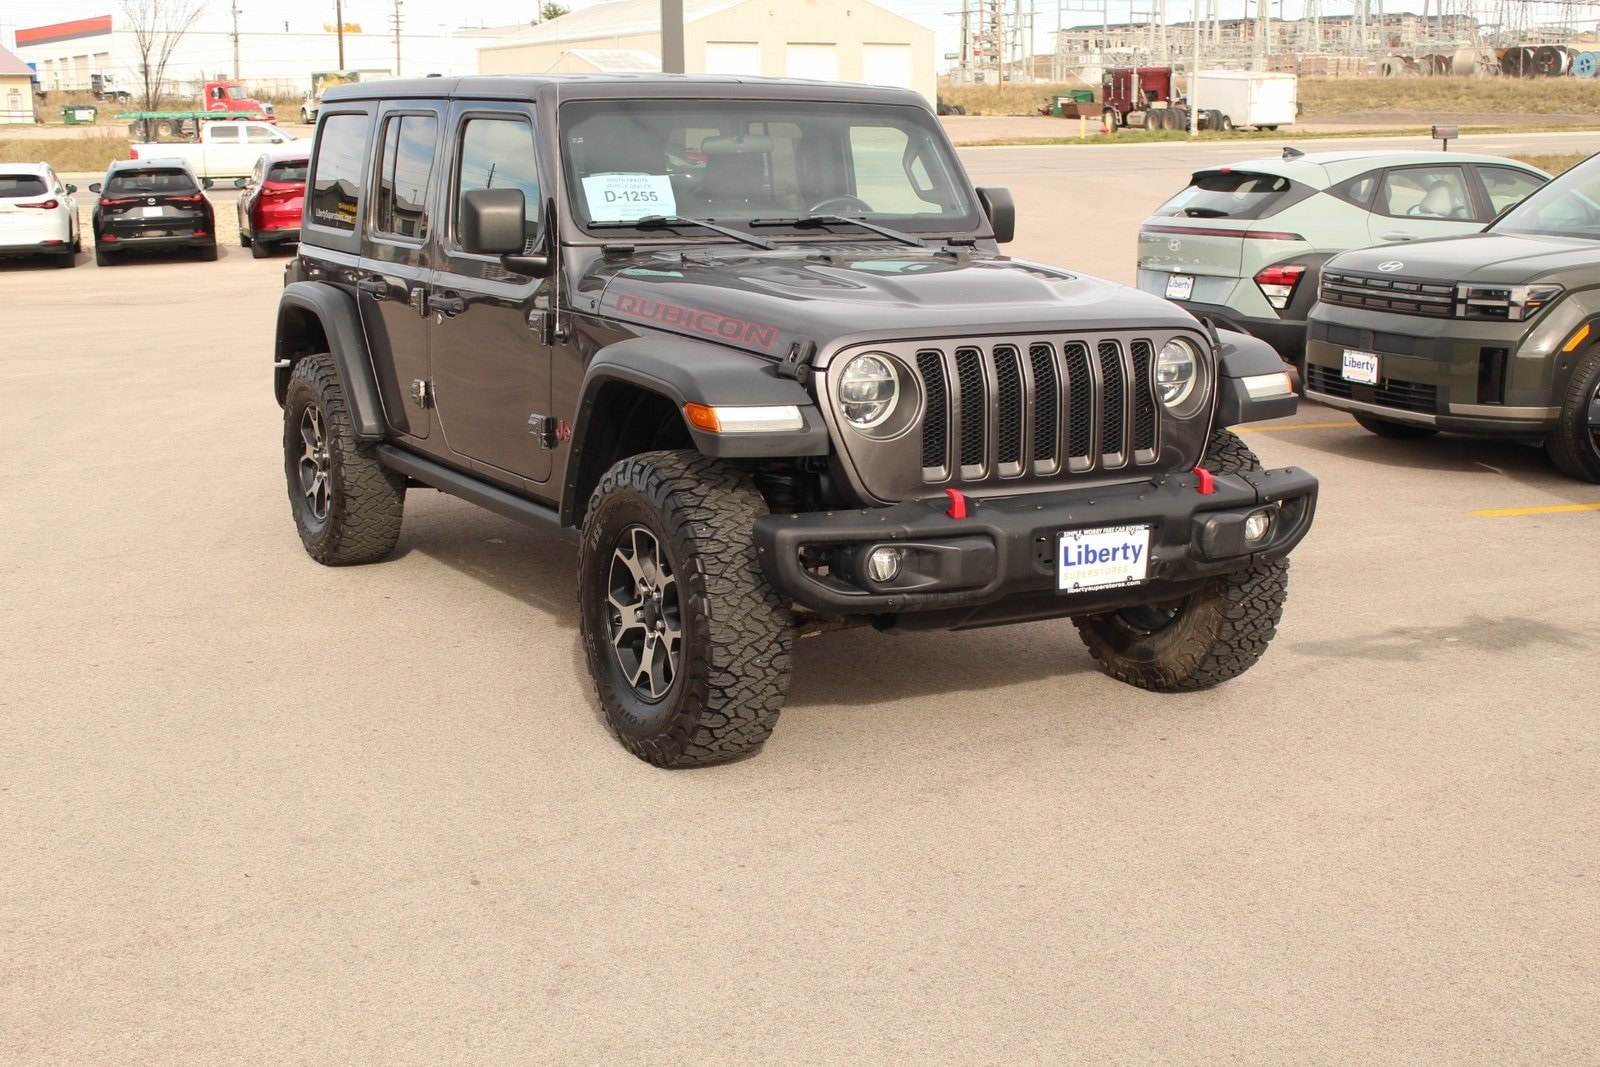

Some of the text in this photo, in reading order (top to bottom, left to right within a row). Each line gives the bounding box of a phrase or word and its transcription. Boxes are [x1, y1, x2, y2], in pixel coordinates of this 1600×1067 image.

[604, 190, 658, 202] D-1255
[1169, 279, 1191, 290] Liberty
[615, 293, 779, 348] RUBICON
[1344, 356, 1375, 373] Liberty
[1063, 543, 1143, 567] Liberty
[1063, 565, 1129, 580] SUPERSTORES
[1067, 580, 1141, 593] libertysuperstores.com
